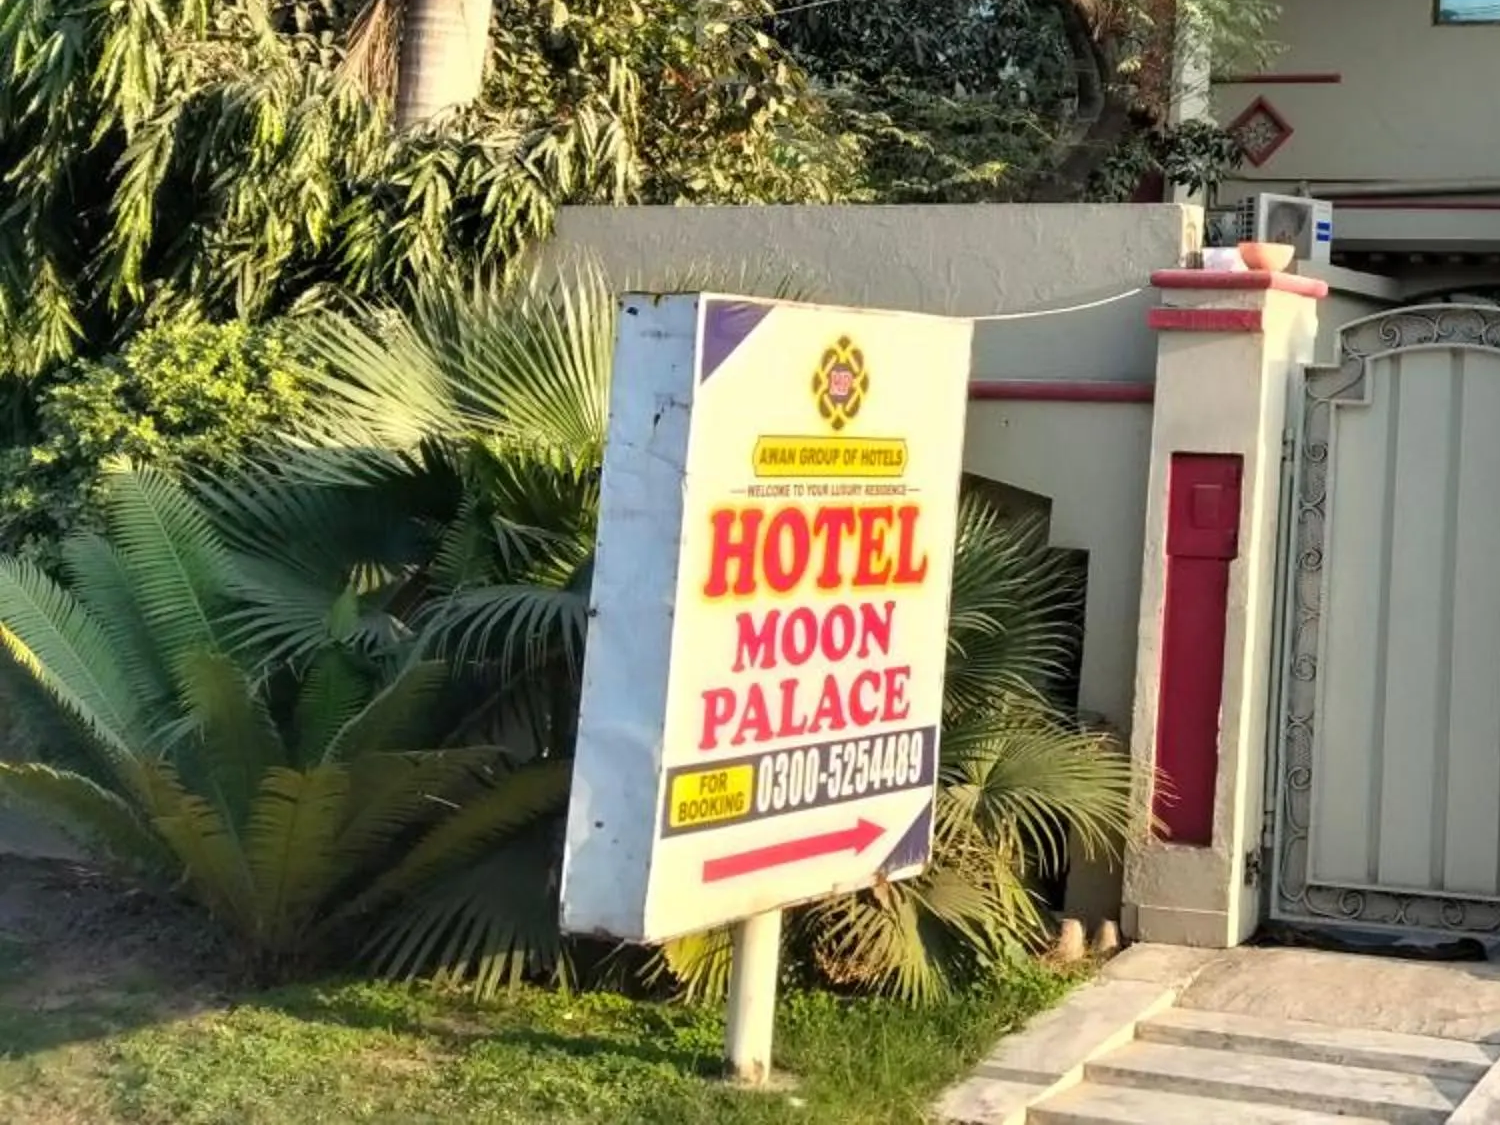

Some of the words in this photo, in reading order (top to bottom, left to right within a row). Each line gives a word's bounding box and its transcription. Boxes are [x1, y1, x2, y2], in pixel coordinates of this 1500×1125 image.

[759, 447, 798, 466] AWAN
[800, 447, 841, 466] GROUP
[843, 449, 857, 466] OF
[861, 449, 903, 466] HOTELS
[748, 484, 791, 497] WELCOME
[793, 484, 805, 496] TO
[807, 484, 829, 496] YOUR
[703, 504, 928, 598] HOTEL
[731, 600, 896, 673] MOON
[698, 665, 911, 750] PALACE
[700, 772, 728, 796] FOR
[756, 730, 924, 813] 0300-5254489
[677, 791, 745, 823] BOOKING
